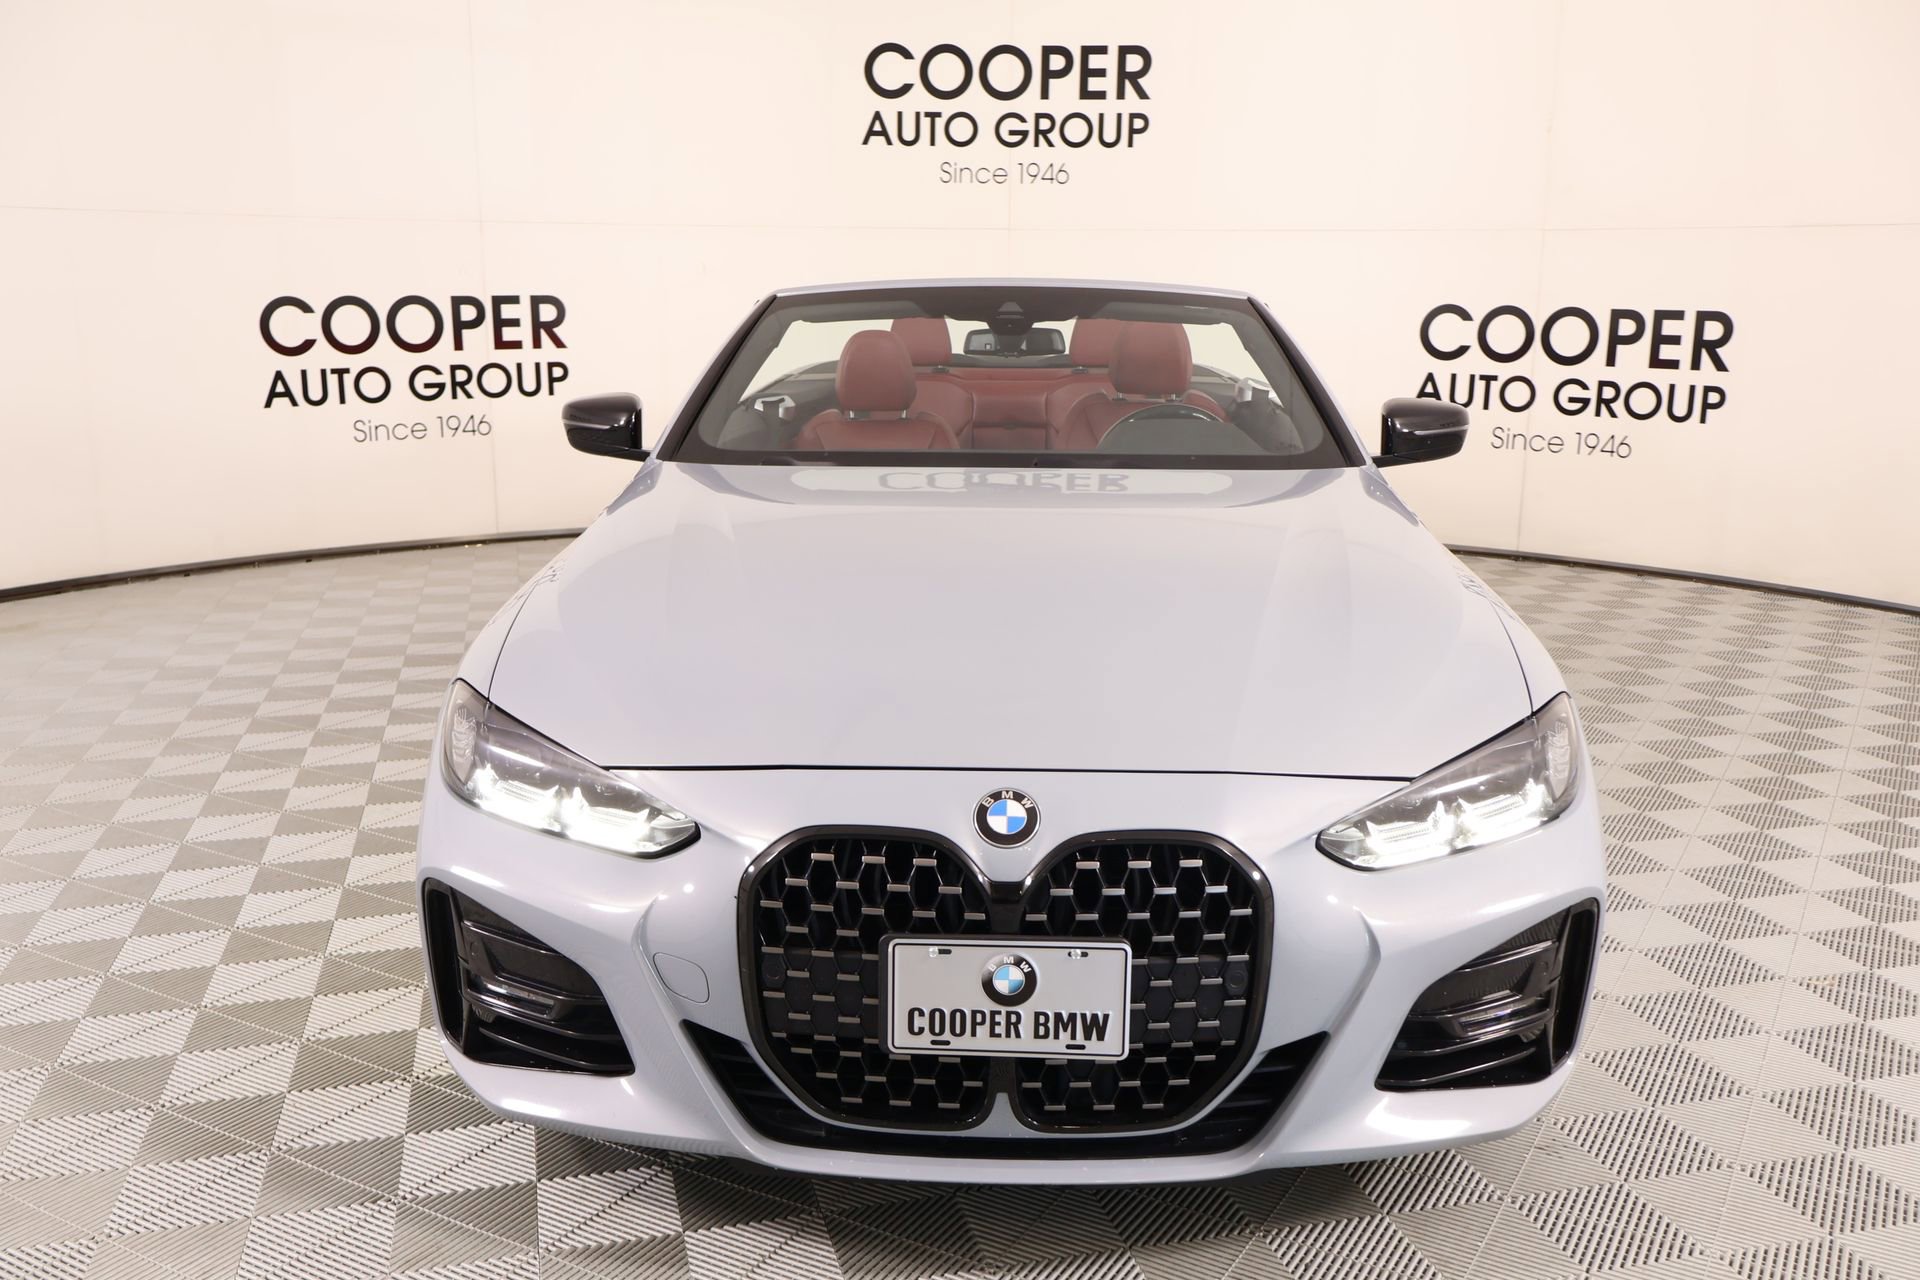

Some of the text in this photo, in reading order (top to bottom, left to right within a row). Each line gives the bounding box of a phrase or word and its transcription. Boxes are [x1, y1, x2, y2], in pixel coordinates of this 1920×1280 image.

[864, 42, 1152, 101] COOPER
[861, 110, 1150, 148] AUTO GROUP
[939, 161, 1070, 185] Since 1946
[260, 295, 568, 356] COOPER
[1420, 304, 1734, 372] COOPER
[264, 362, 569, 408] AUTO GROUP
[1416, 372, 1727, 424] AUTO GROUP
[352, 414, 492, 443] Since 1946
[1491, 426, 1632, 459] Since 1946
[981, 790, 1034, 809] BMW
[988, 956, 1031, 973] BMW
[907, 1007, 1110, 1042] COOPER BMW
